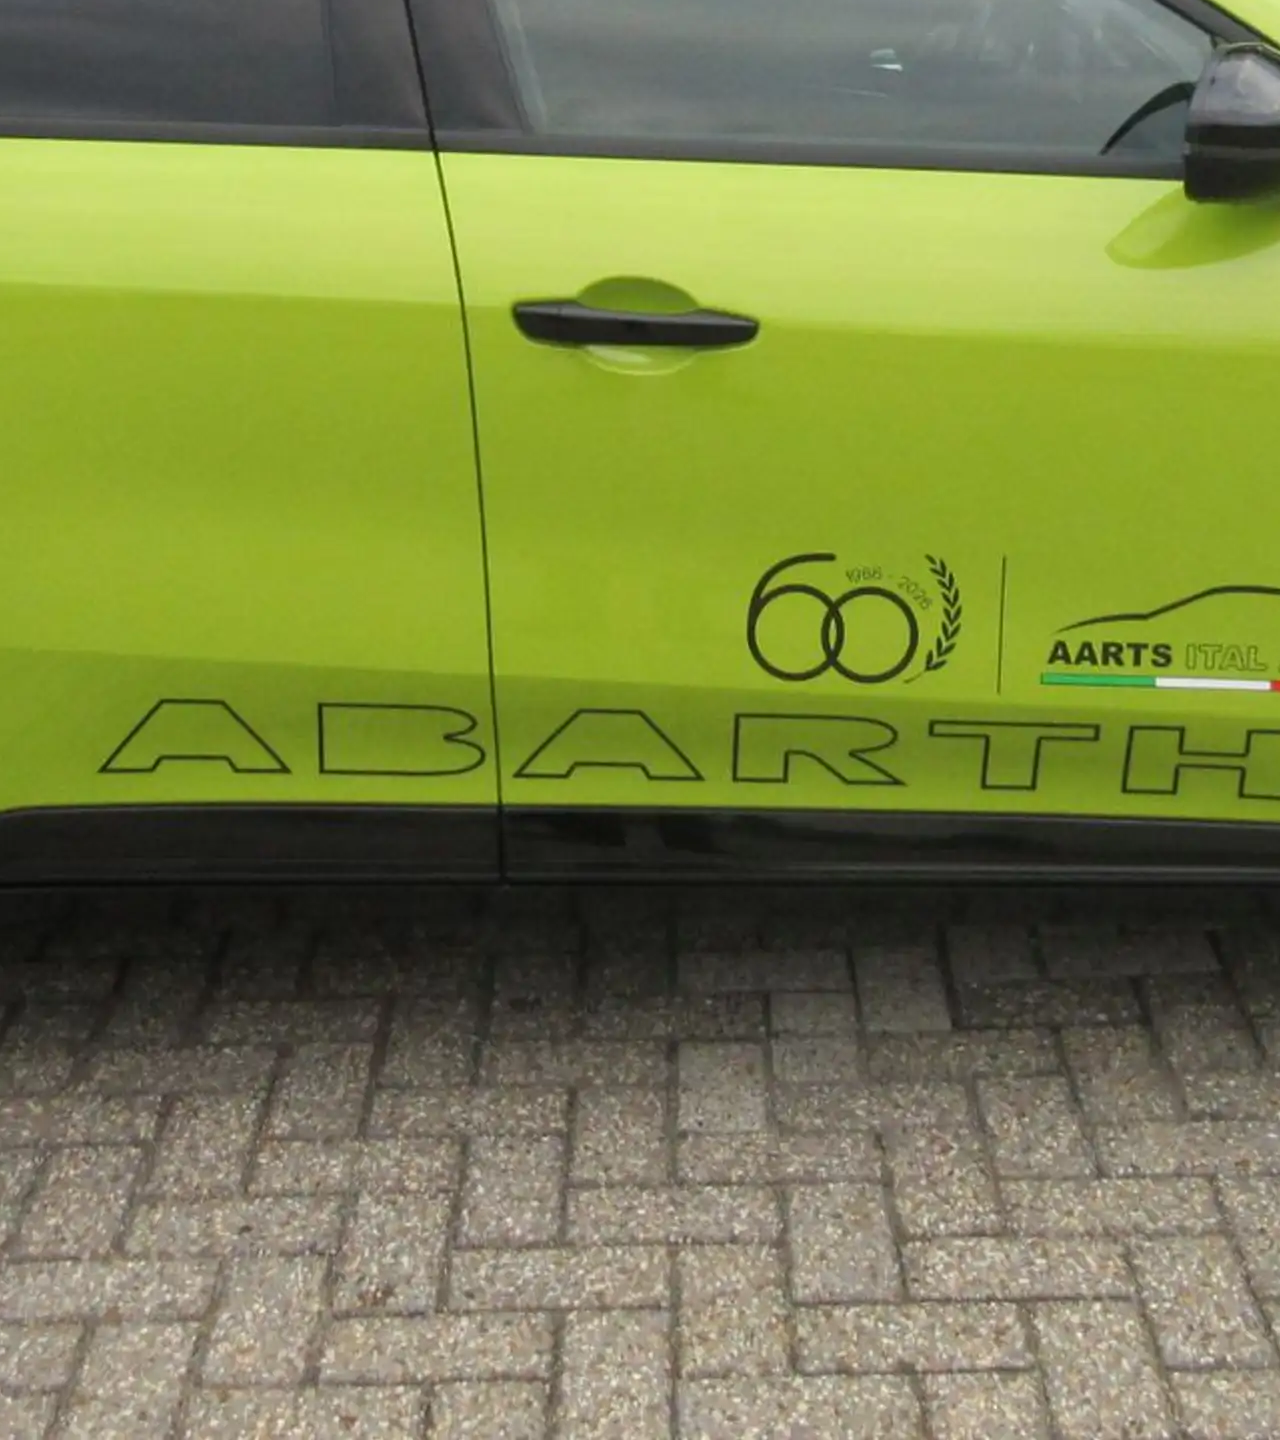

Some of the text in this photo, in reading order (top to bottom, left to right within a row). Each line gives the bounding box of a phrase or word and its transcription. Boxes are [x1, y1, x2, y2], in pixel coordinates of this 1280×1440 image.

[746, 552, 920, 684] 60
[1047, 640, 1173, 667] AARTS
[1185, 643, 1269, 672] ITAL
